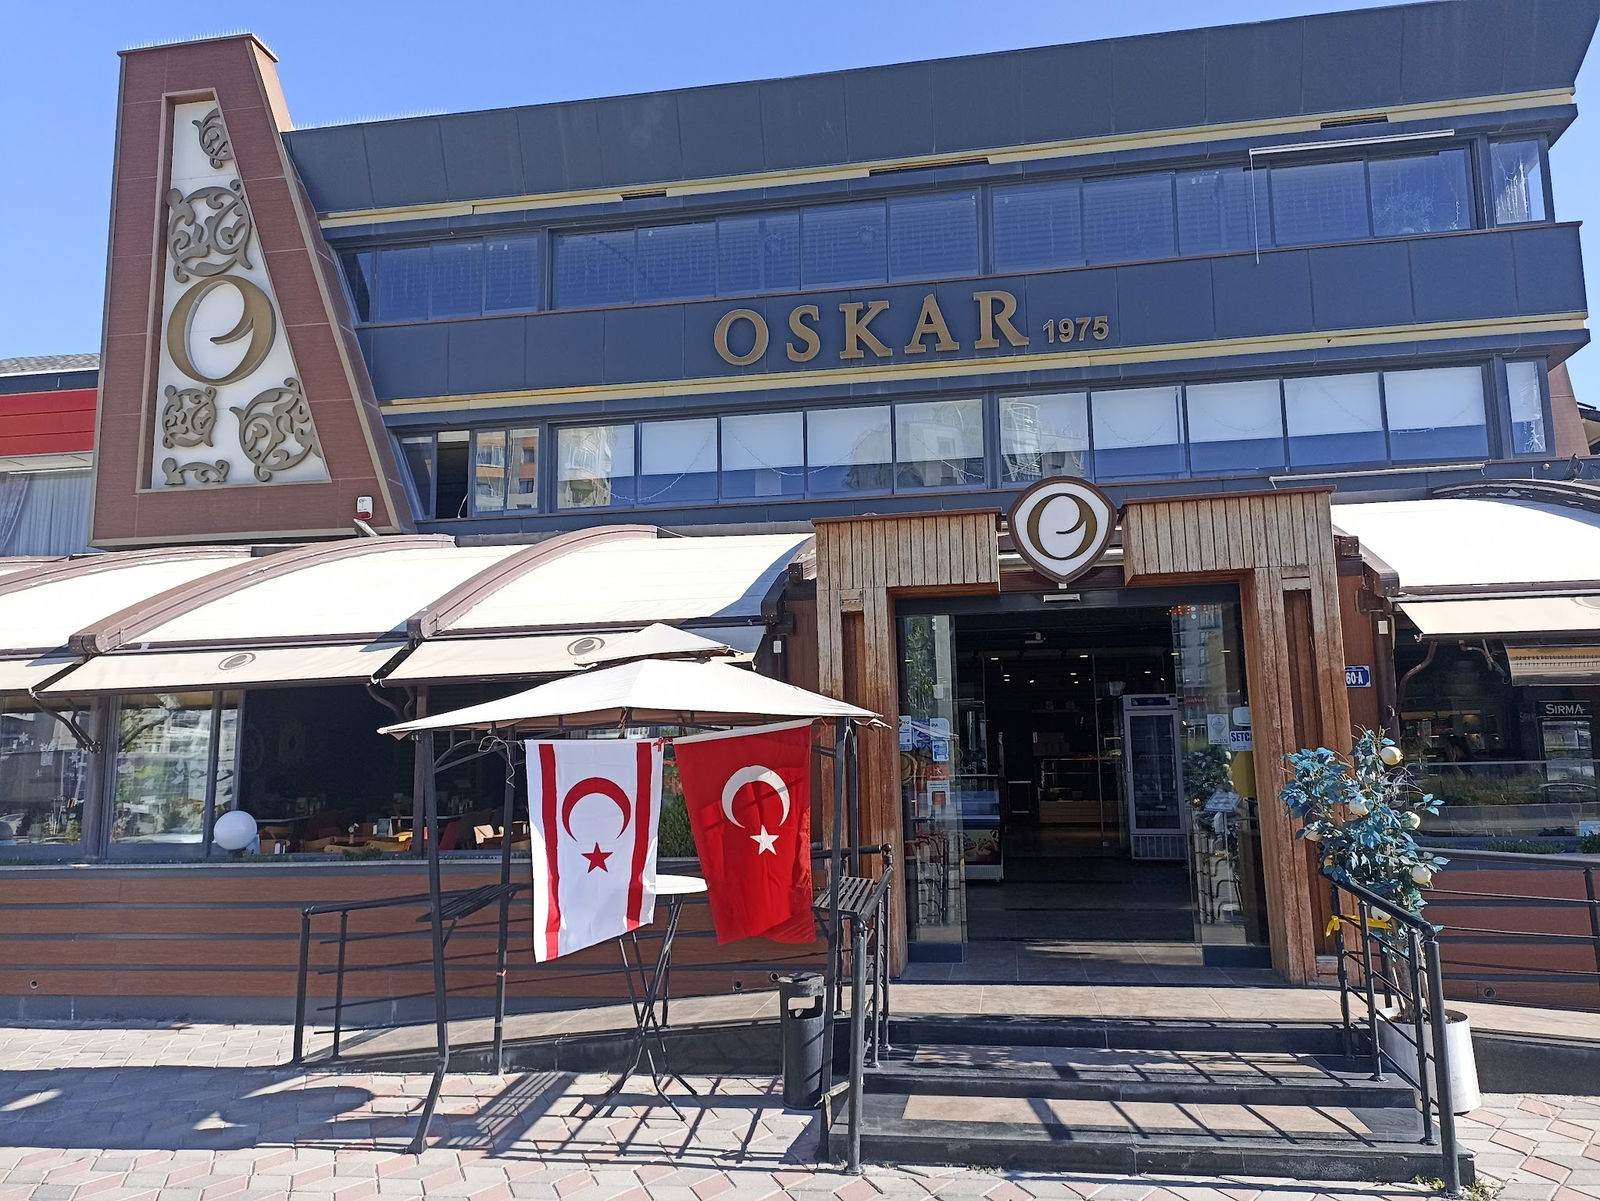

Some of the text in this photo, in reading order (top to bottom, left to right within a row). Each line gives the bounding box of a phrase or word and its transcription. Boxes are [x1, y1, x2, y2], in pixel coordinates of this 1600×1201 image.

[713, 290, 1110, 366] OSKAR 1975
[1545, 703, 1587, 715] SIRMA
[1230, 731, 1253, 742] SETC
